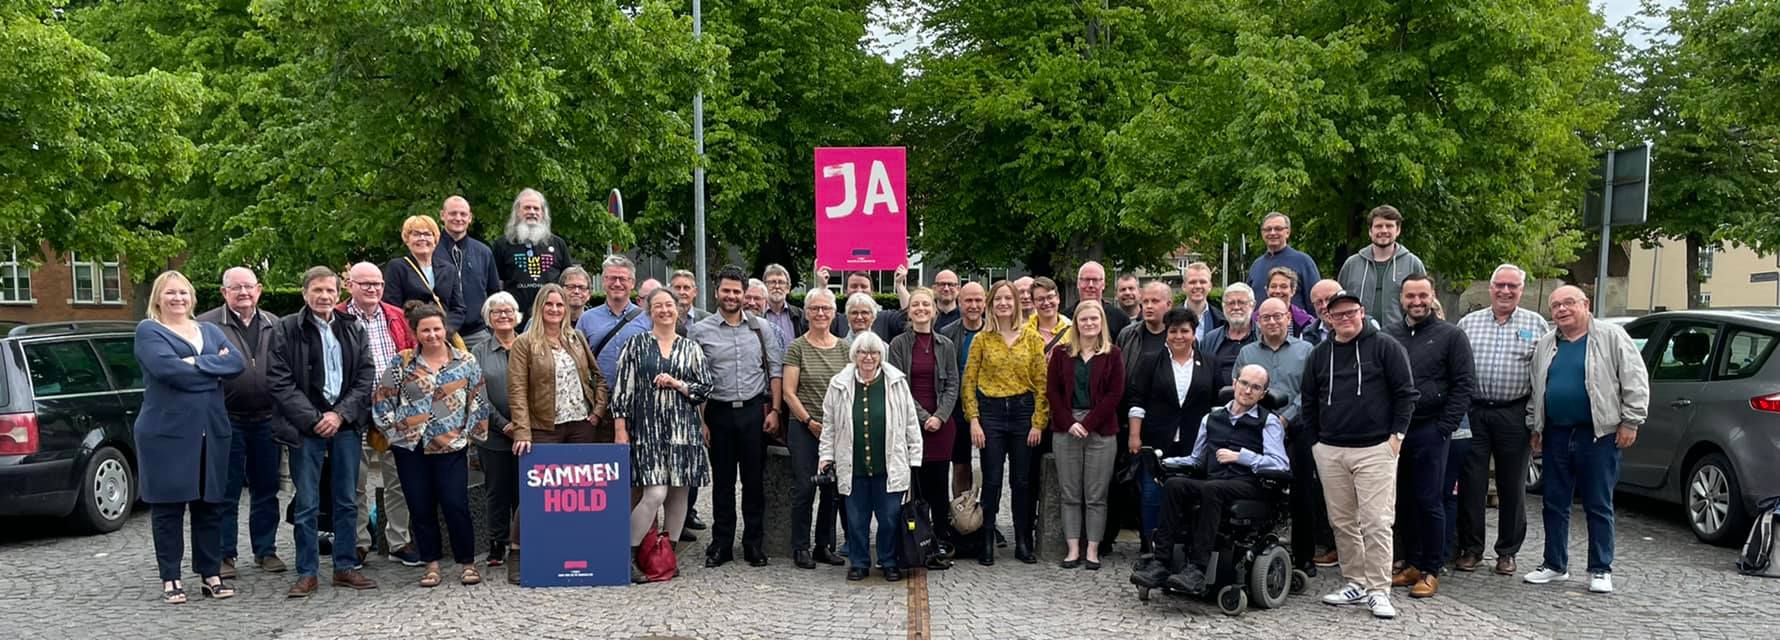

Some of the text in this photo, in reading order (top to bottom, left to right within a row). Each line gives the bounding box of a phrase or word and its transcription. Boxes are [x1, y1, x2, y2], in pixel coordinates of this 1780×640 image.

[823, 160, 899, 219] JA
[527, 461, 620, 487] SAMMEN
[544, 488, 607, 512] HOLD
